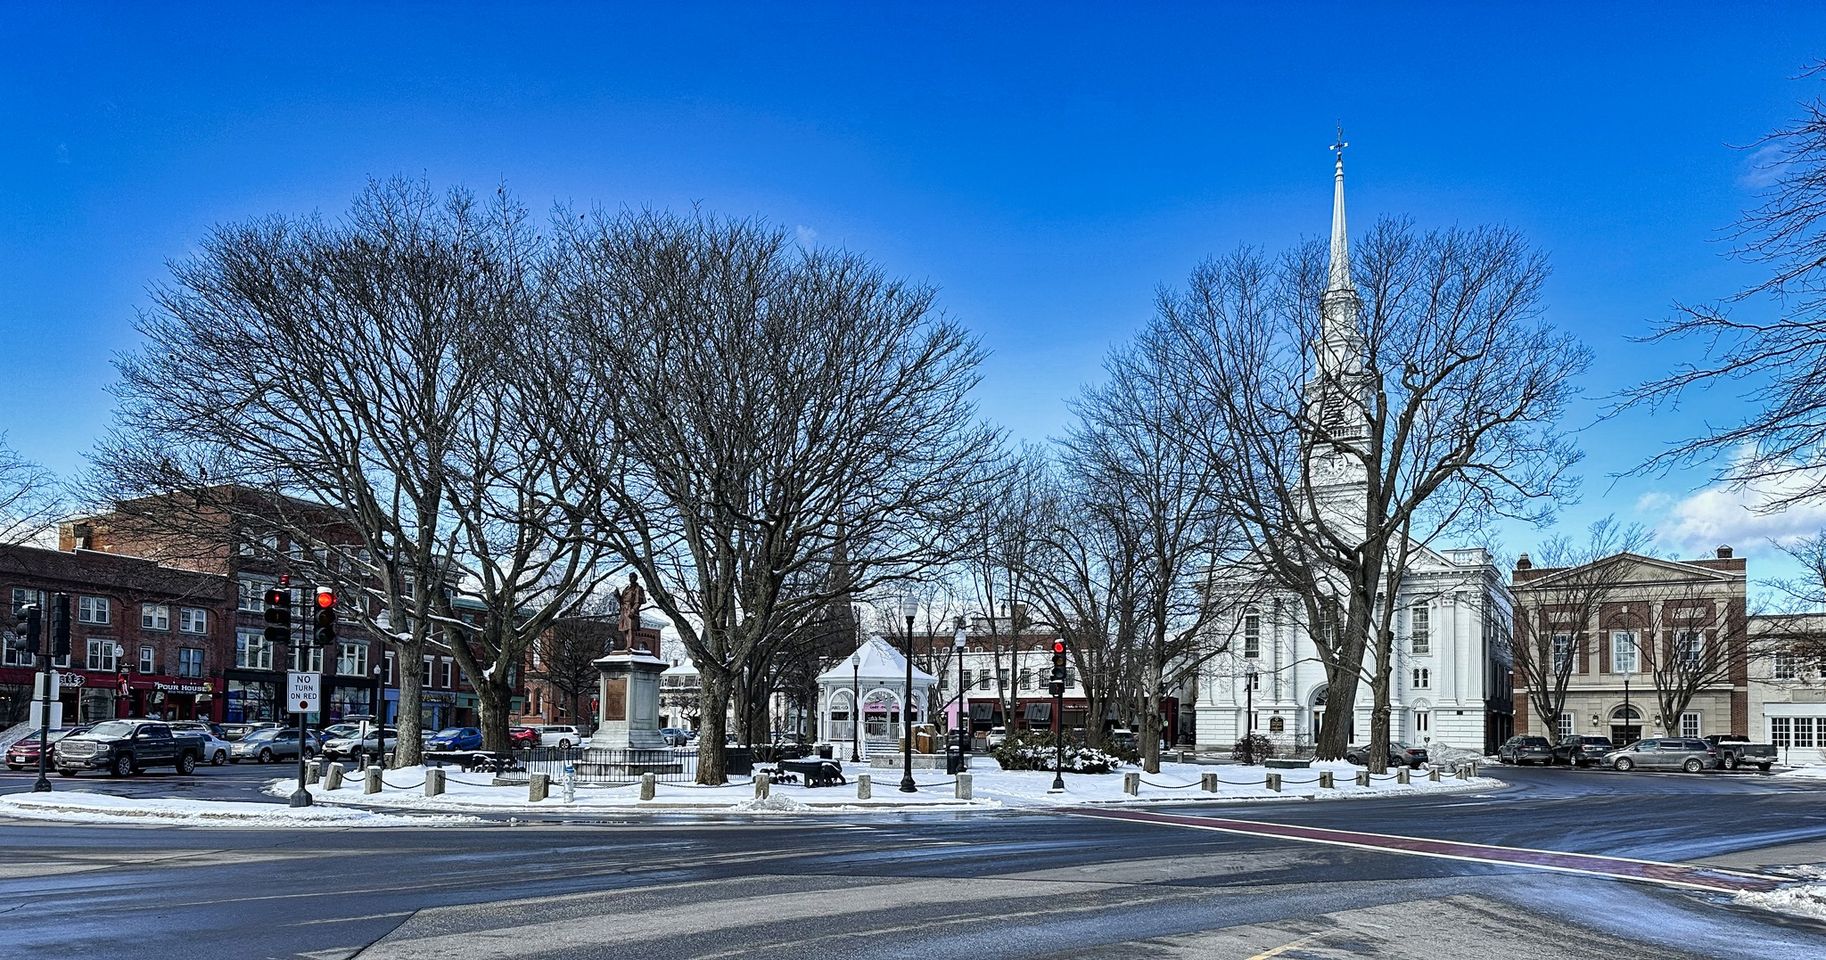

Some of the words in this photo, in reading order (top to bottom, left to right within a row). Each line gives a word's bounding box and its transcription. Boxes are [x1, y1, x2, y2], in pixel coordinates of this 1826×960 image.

[296, 675, 311, 684] NO
[157, 683, 180, 691] POUR
[181, 684, 207, 692] HOUSE
[295, 684, 314, 692] TURN
[290, 692, 301, 700] ON
[303, 692, 318, 700] RED
